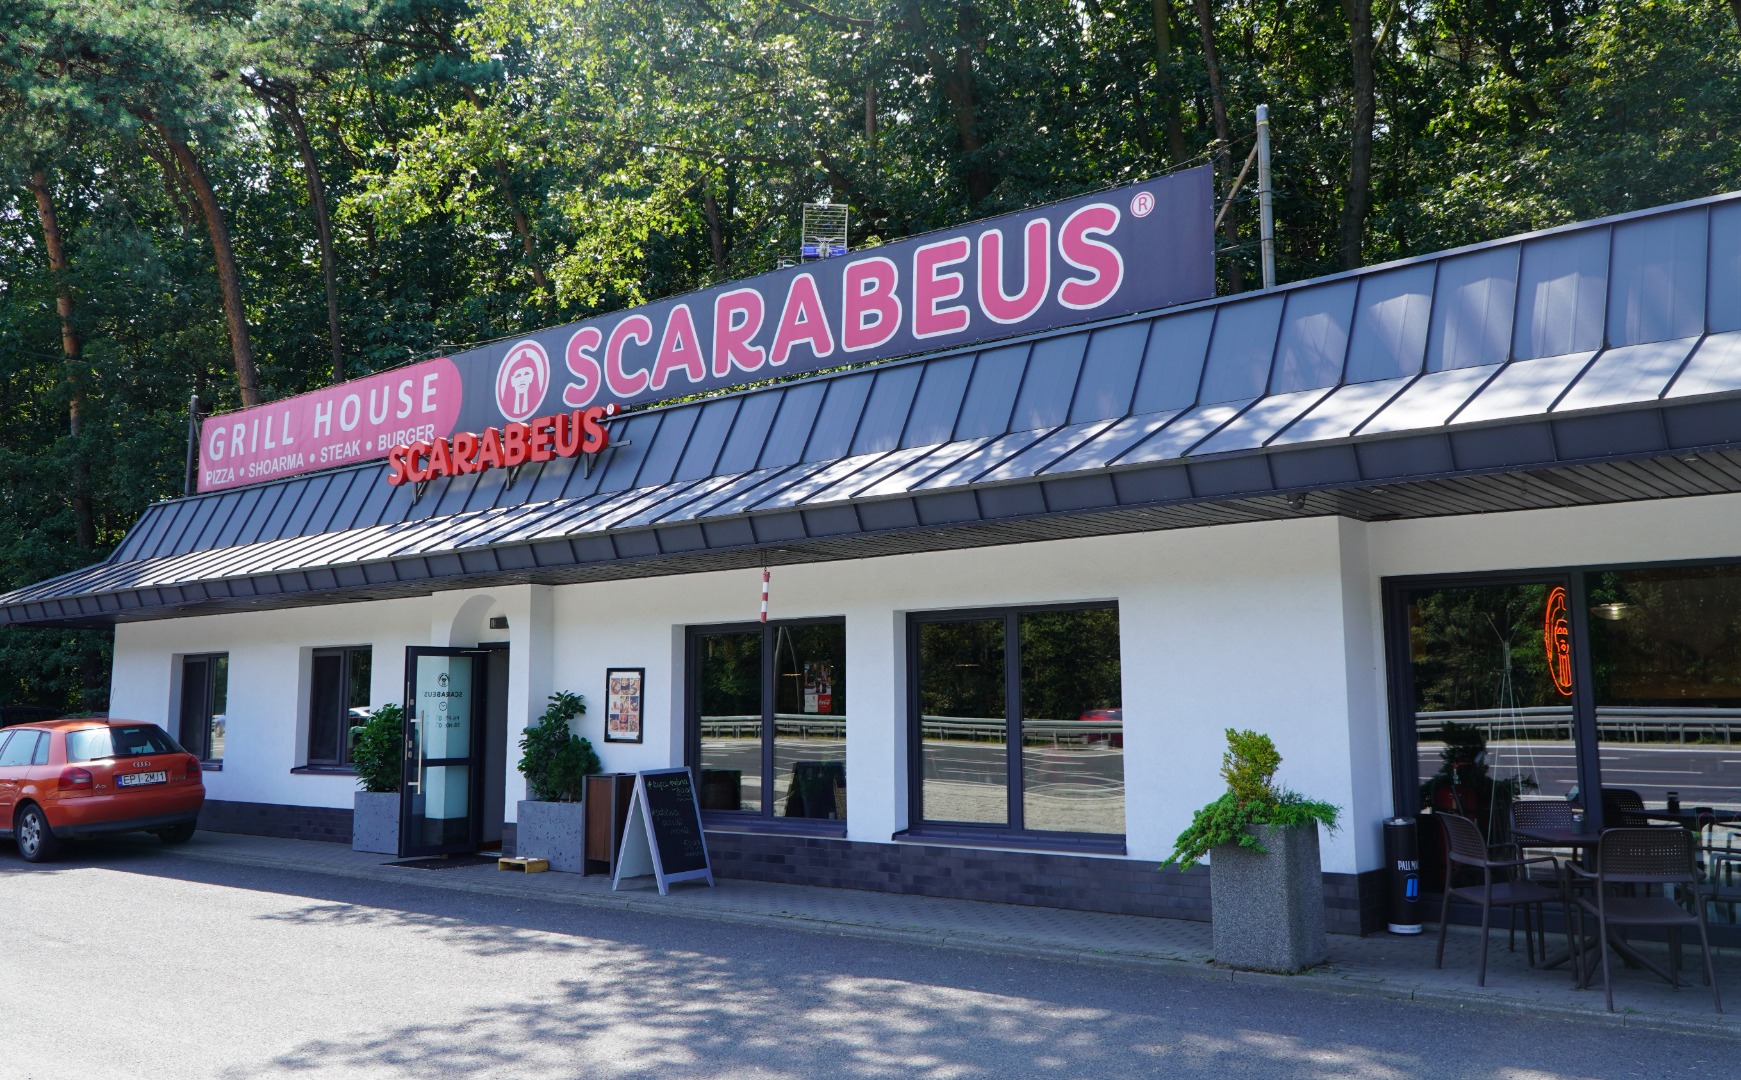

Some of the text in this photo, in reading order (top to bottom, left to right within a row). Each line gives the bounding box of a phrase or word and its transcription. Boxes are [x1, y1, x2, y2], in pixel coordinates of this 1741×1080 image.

[564, 203, 1125, 408] SCARABEUS
[205, 423, 435, 486] PIZZA SHOARMA STEAK BURGER
[209, 372, 439, 461] GRILL HOUSE
[387, 405, 609, 486] SCARABEUS
